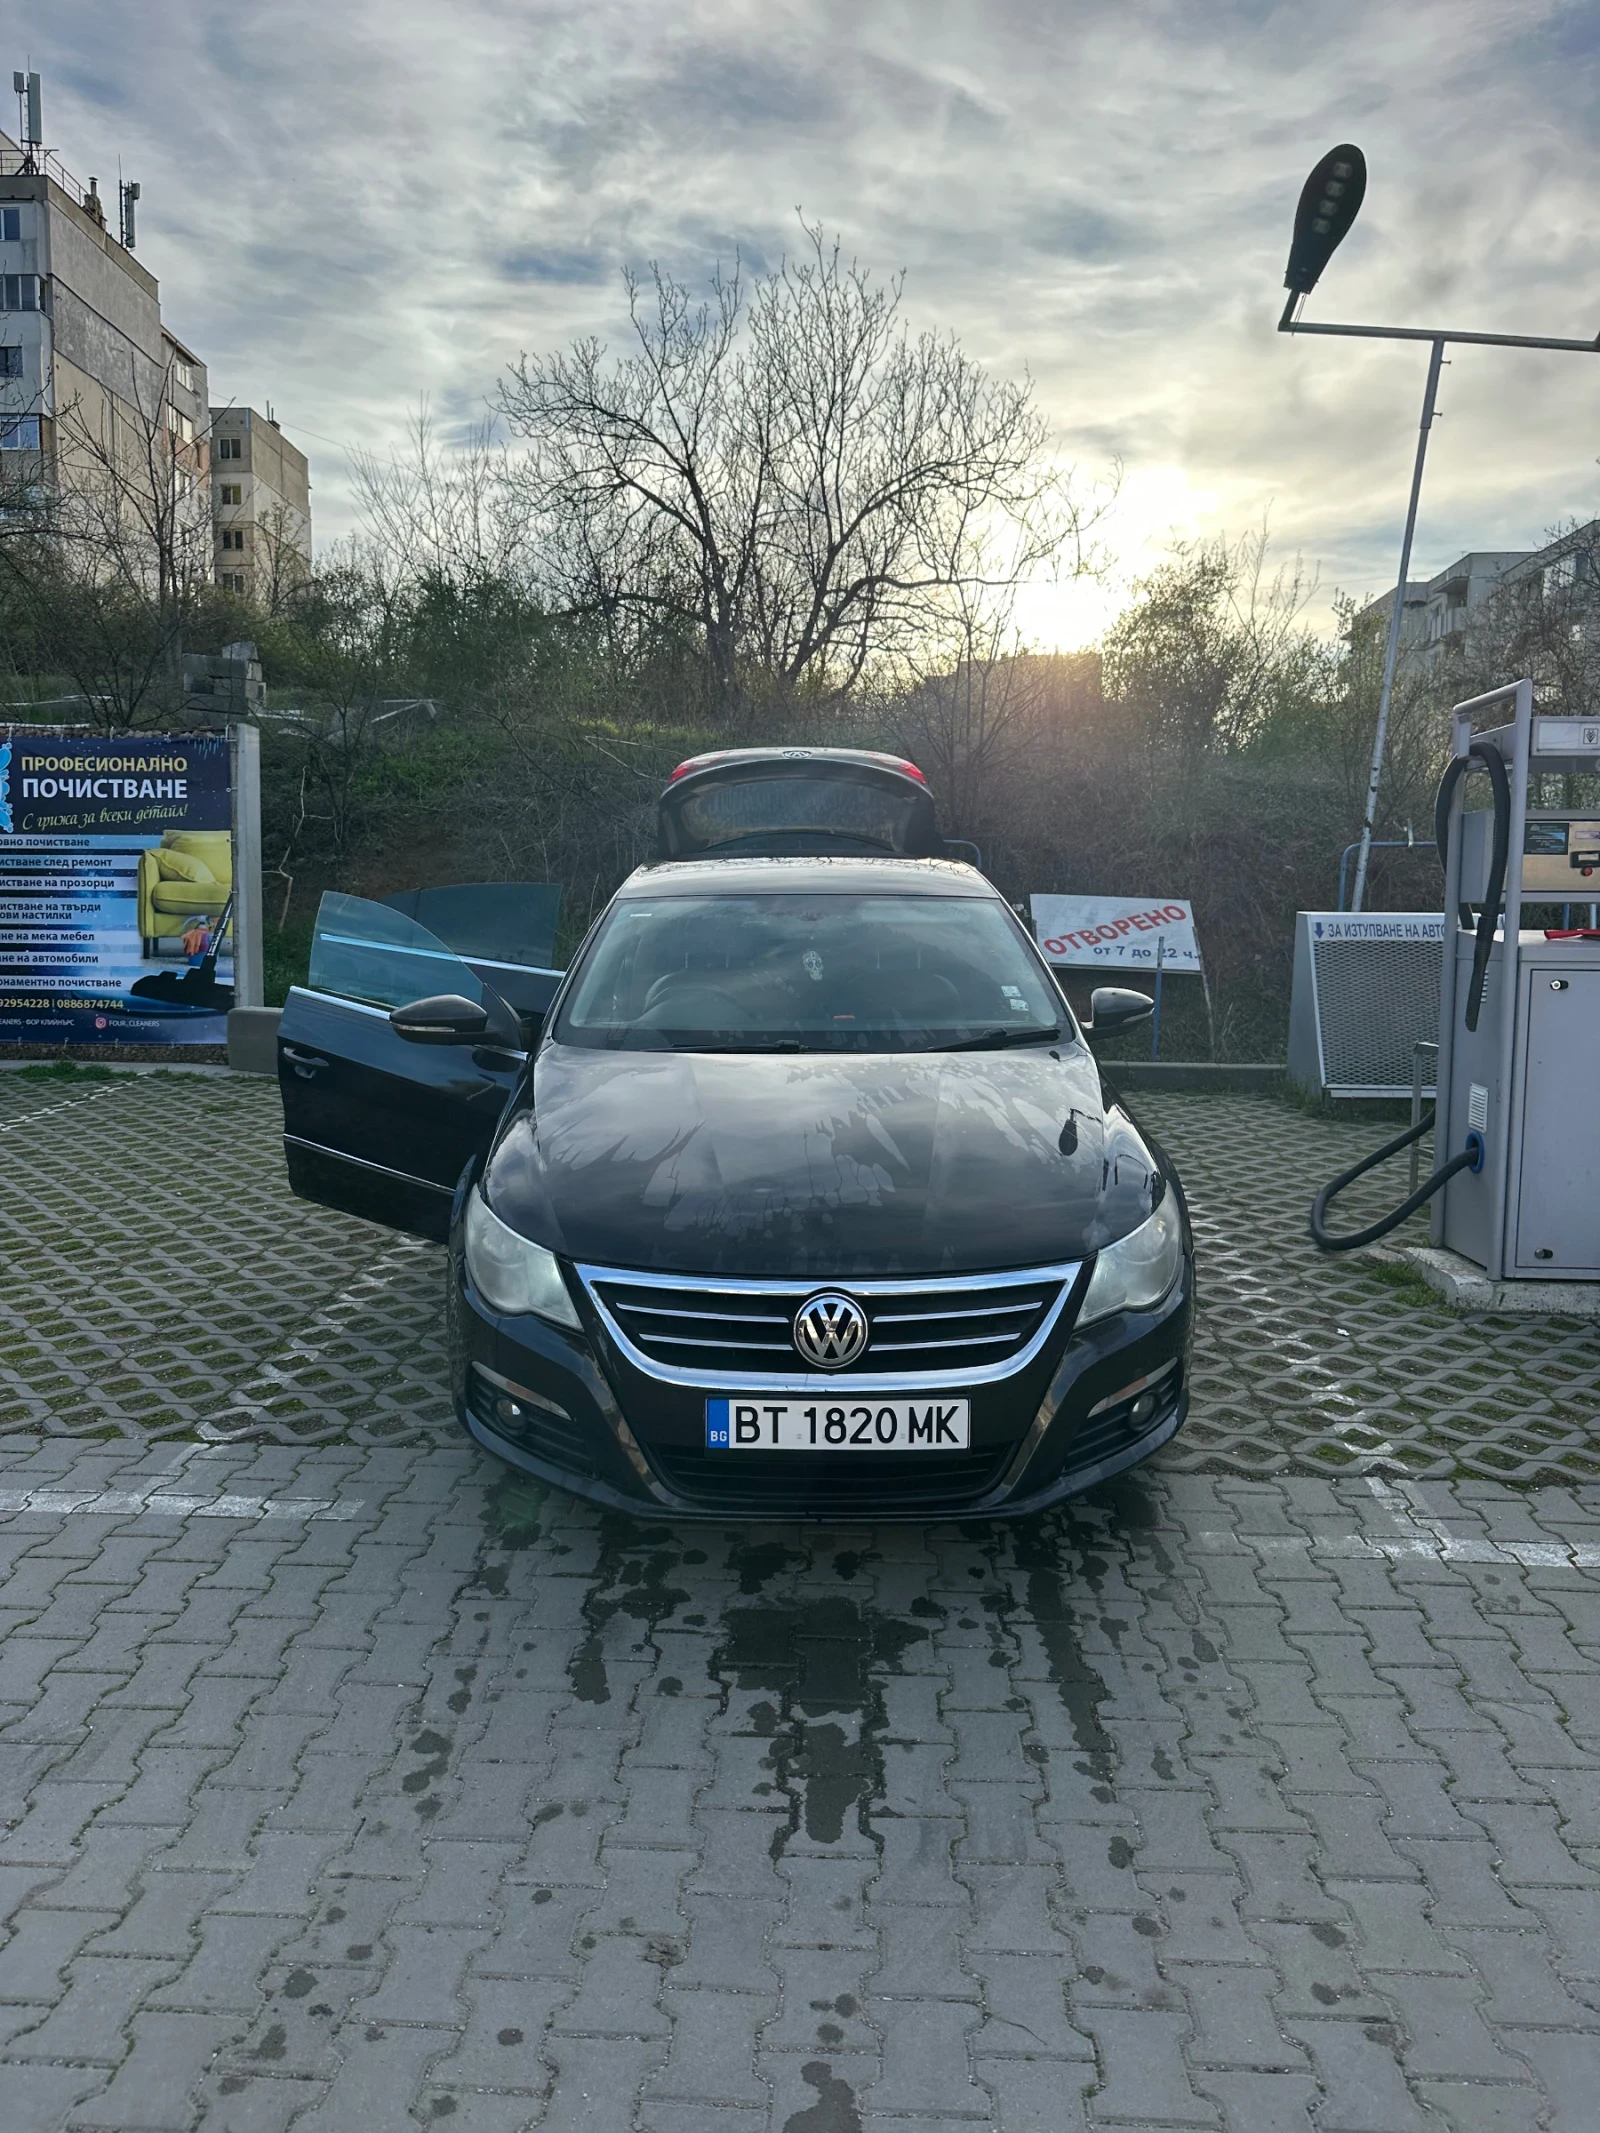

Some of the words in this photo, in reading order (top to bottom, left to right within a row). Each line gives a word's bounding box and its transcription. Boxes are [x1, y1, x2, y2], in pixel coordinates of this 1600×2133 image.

[21, 756, 188, 772] ПРОФЕСИОНАЛНО
[22, 778, 188, 799] ПОЧИСТВАНЕ
[22, 812, 34, 831] С
[37, 814, 78, 831] грижа
[78, 813, 95, 828] за
[100, 807, 132, 823] всеки
[134, 803, 188, 824] детайл!
[26, 838, 90, 847] почистване
[44, 859, 69, 868] след
[72, 859, 113, 869] ремонт
[45, 879, 58, 887] на
[60, 879, 115, 889] прозорци
[46, 903, 58, 911] на
[61, 904, 101, 913] твърди
[22, 912, 72, 920] настилки
[1043, 905, 1187, 954] ОТВОРЕНО
[1328, 923, 1343, 938] ЗА
[1344, 923, 1403, 938] ИЗТУПВАНЕ
[1405, 923, 1420, 938] НА
[16, 932, 29, 941] на
[31, 933, 58, 941] мека
[60, 931, 95, 941] мебел
[1093, 947, 1111, 955] от
[1116, 945, 1125, 955] 7
[1132, 948, 1151, 958] до
[17, 954, 30, 963] на
[32, 953, 99, 963] автомобили
[58, 979, 122, 988] почистване
[735, 1406, 788, 1443] BT
[804, 1406, 898, 1444] 1820
[908, 1405, 960, 1443] MK
[710, 1430, 727, 1442] BG
